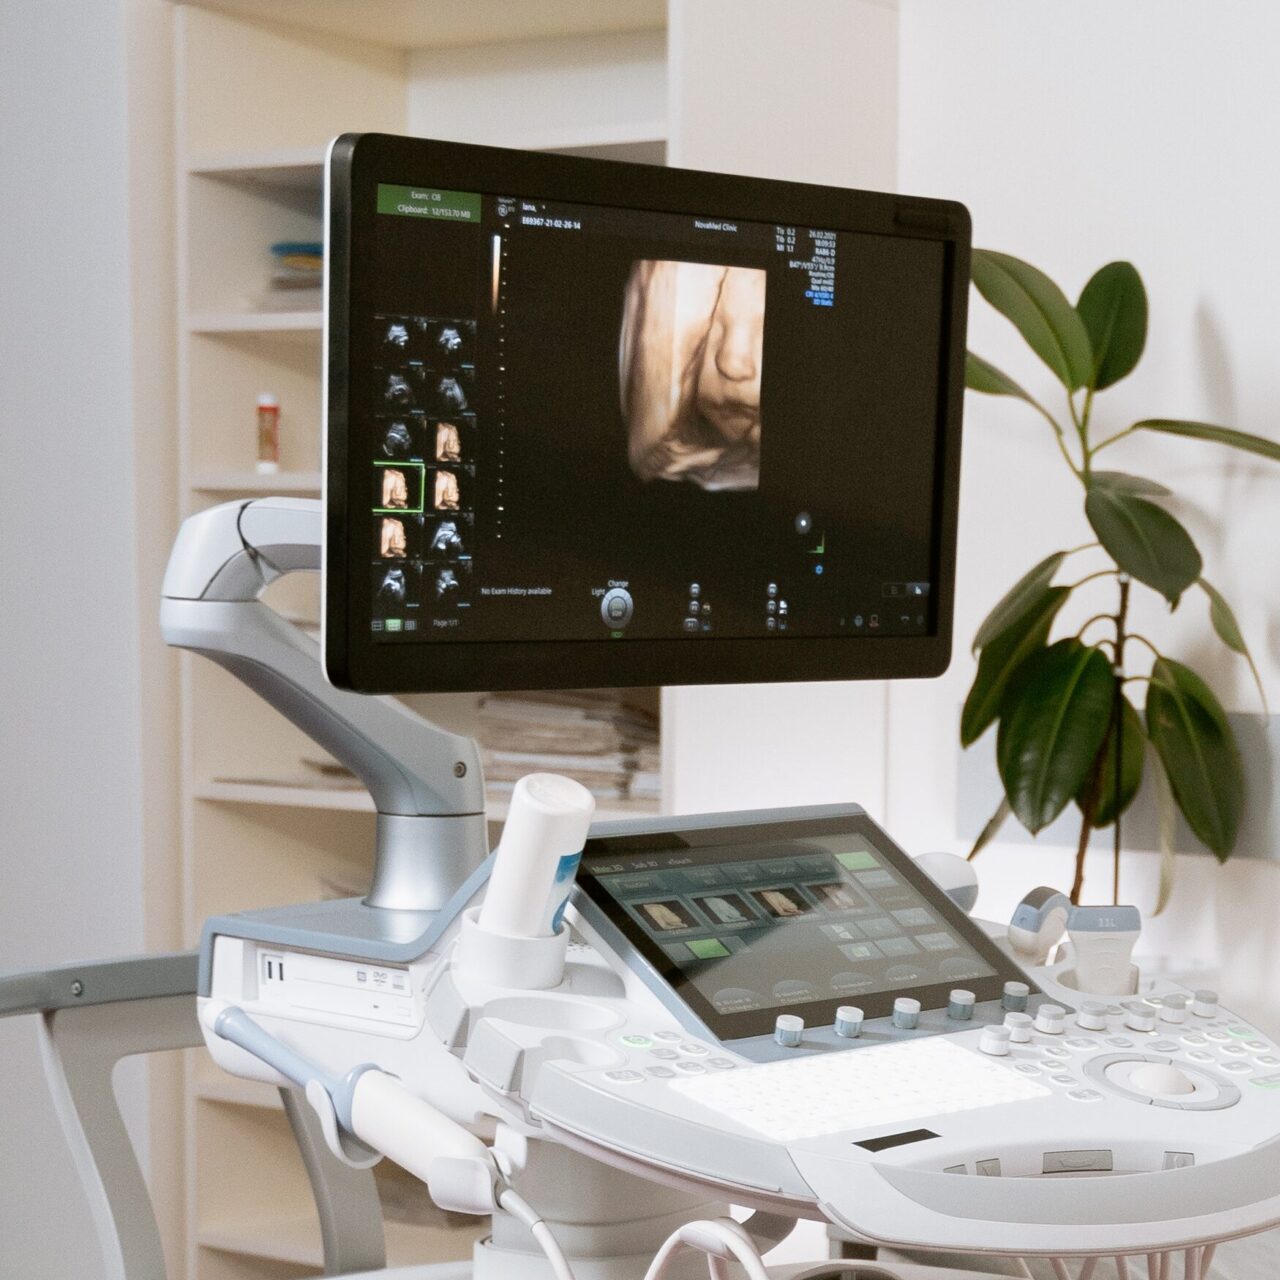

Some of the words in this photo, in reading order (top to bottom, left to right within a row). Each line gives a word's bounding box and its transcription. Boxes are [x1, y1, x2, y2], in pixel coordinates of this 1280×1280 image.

[608, 579, 630, 588] Change
[481, 587, 490, 595] No
[491, 587, 507, 595] Exam
[507, 587, 527, 597] History
[527, 587, 553, 596] available
[591, 588, 606, 597] Light
